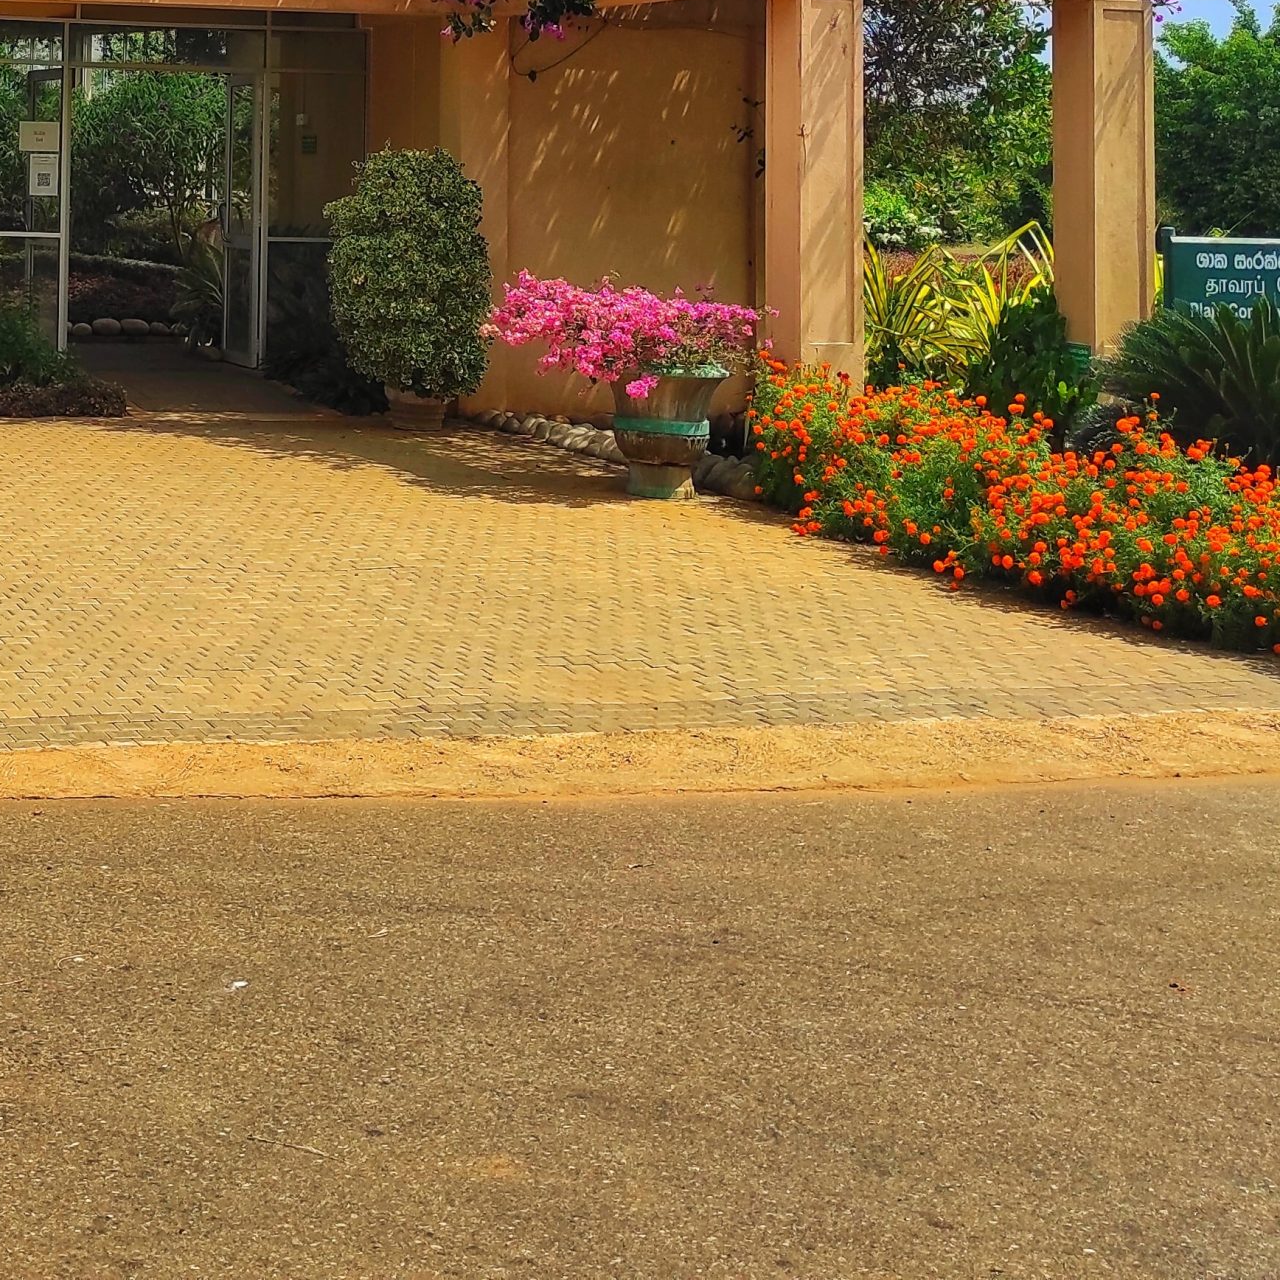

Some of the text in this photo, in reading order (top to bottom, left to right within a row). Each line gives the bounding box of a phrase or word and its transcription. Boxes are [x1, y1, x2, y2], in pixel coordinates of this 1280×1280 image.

[1196, 250, 1280, 270] ශාක සංරක්
[1205, 275, 1265, 298] தாவரப்
